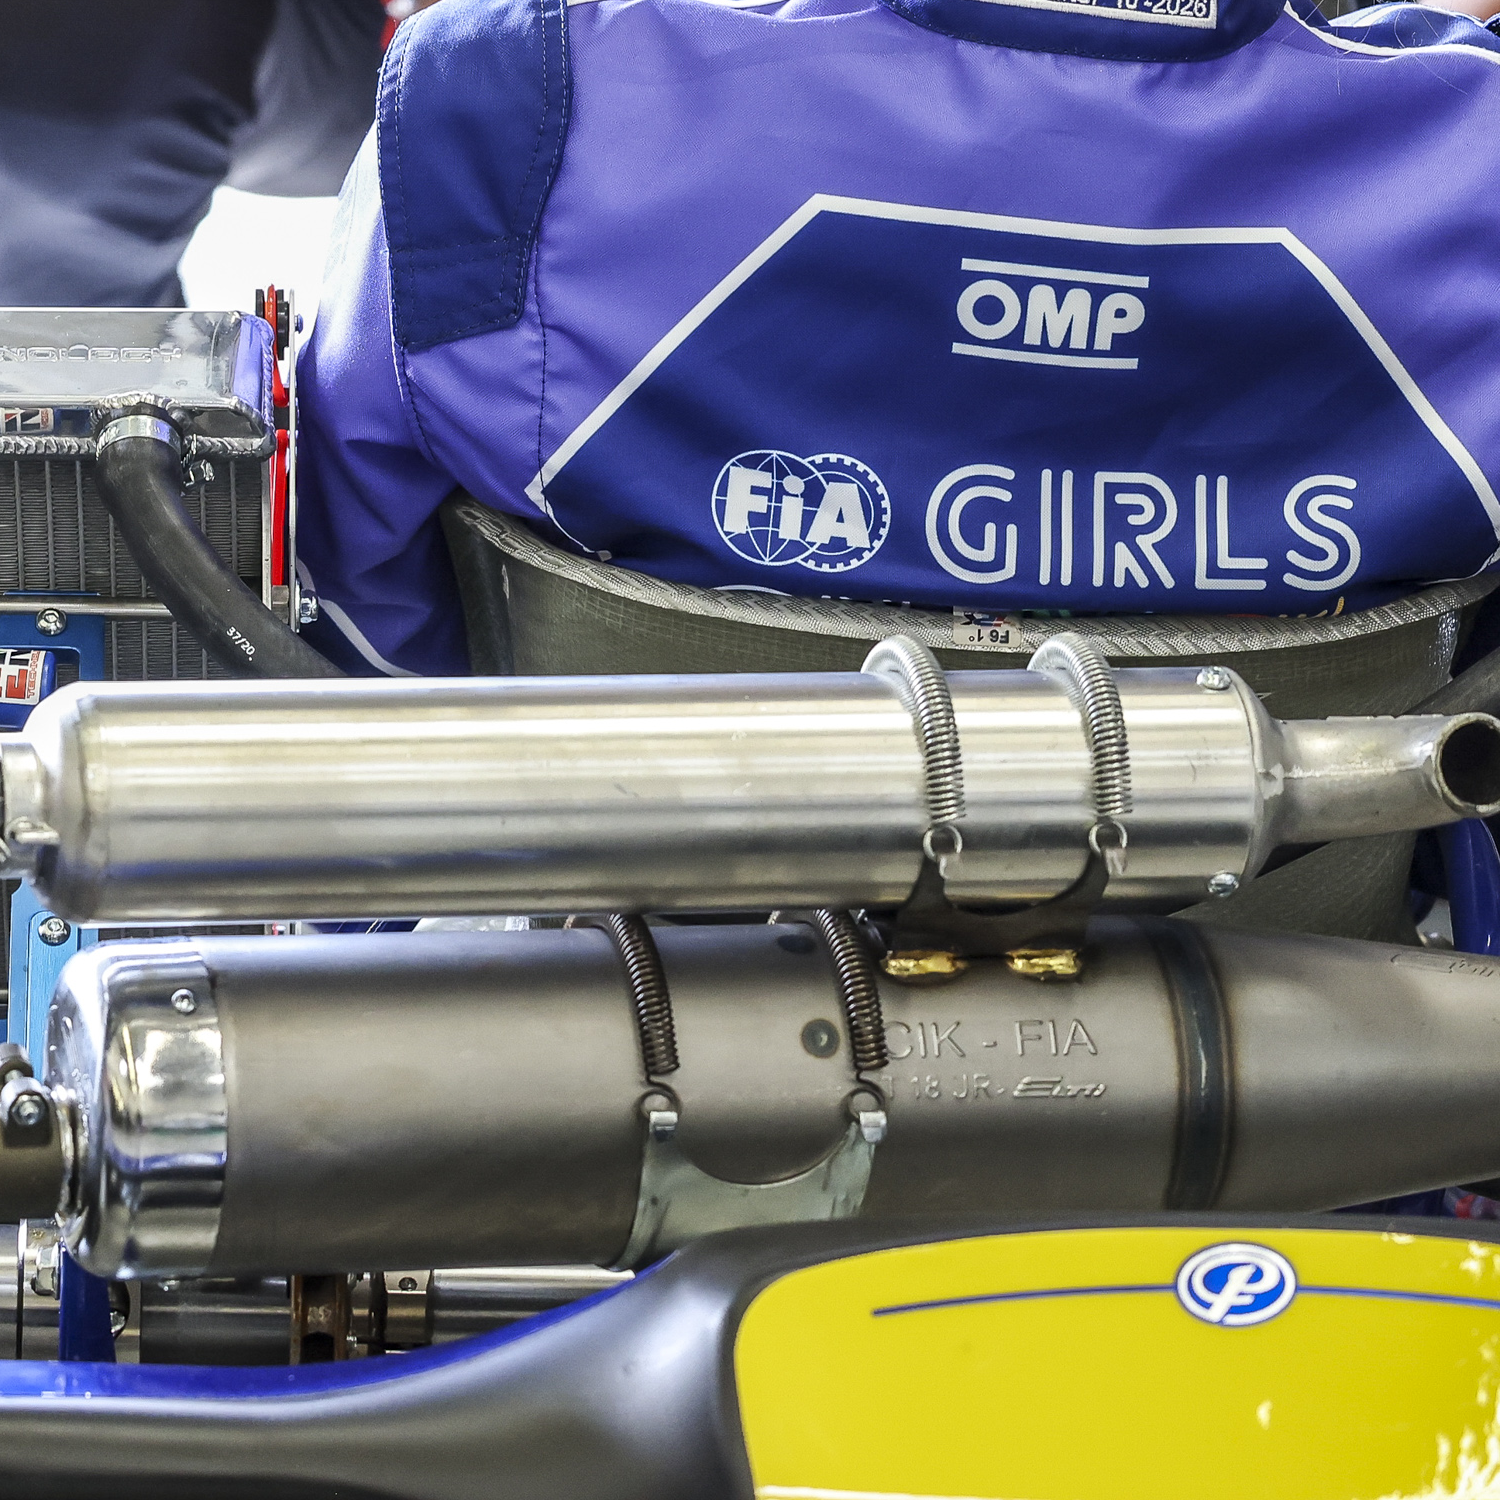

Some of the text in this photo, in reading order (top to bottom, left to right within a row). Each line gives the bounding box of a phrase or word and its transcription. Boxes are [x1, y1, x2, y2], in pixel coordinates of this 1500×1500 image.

[956, 278, 1146, 352] OMP
[925, 463, 1364, 593] GIRLS
[884, 1020, 967, 1059] CIK
[1013, 1018, 1098, 1057] FIA
